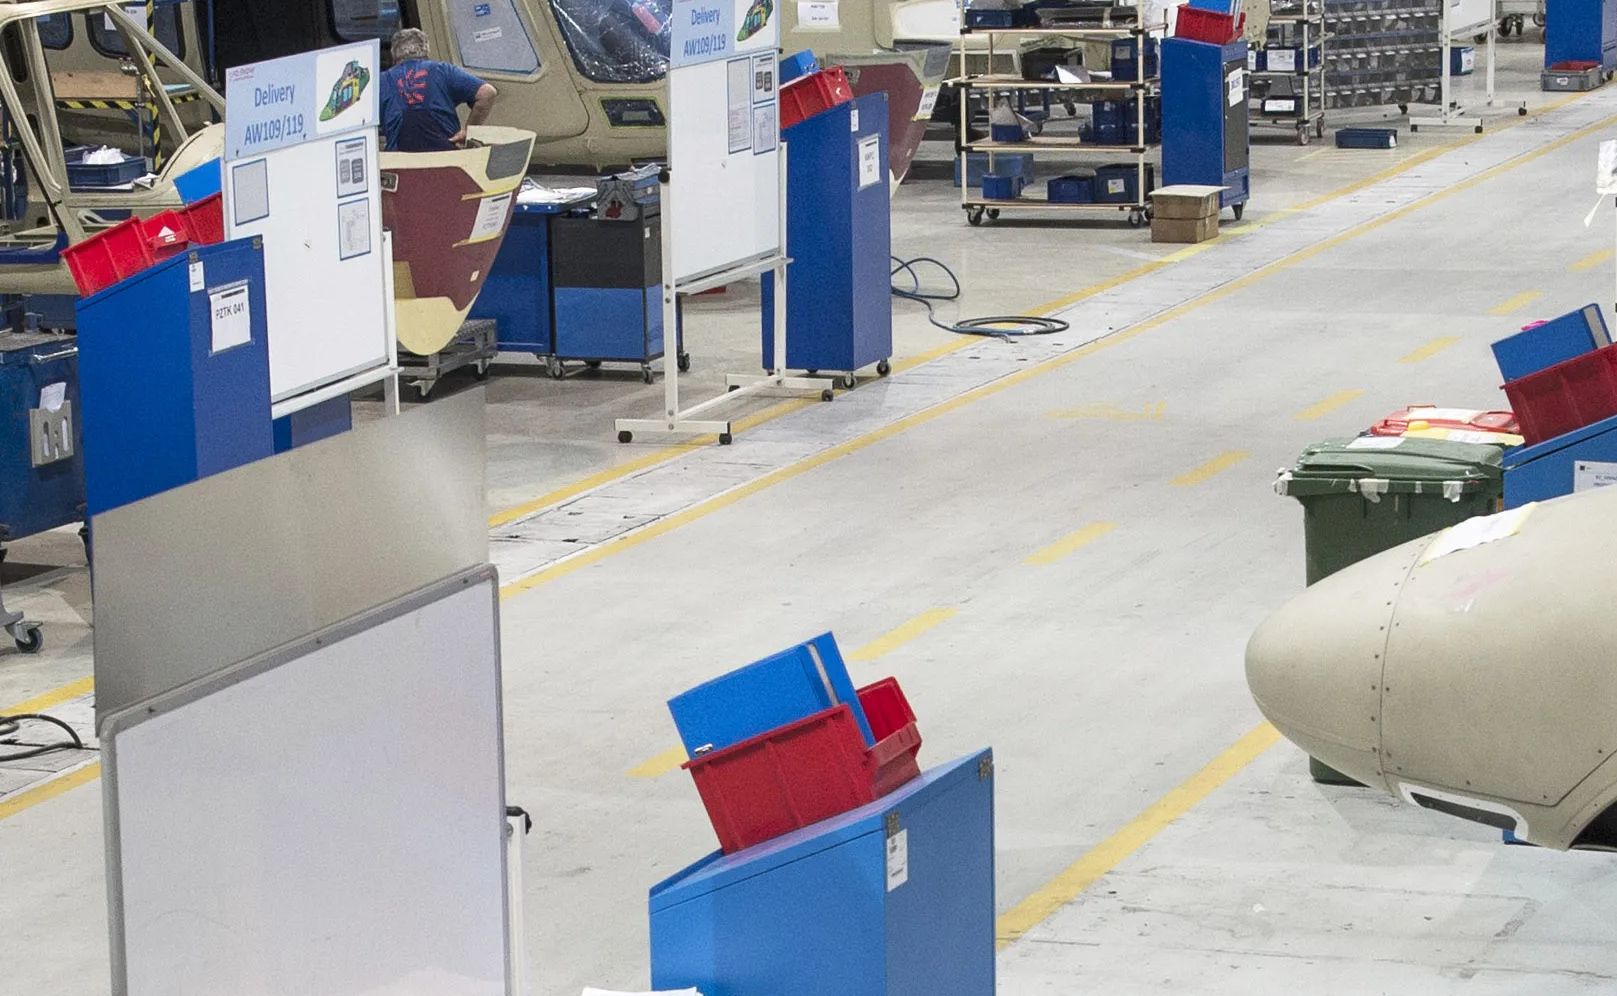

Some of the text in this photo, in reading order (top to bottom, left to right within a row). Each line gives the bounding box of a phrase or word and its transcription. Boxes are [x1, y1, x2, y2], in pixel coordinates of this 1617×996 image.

[691, 6, 721, 26] Delivery
[683, 34, 727, 58] AW109/119
[254, 83, 296, 108] Delivery
[244, 113, 304, 146] AW109/119
[233, 302, 245, 315] 041
